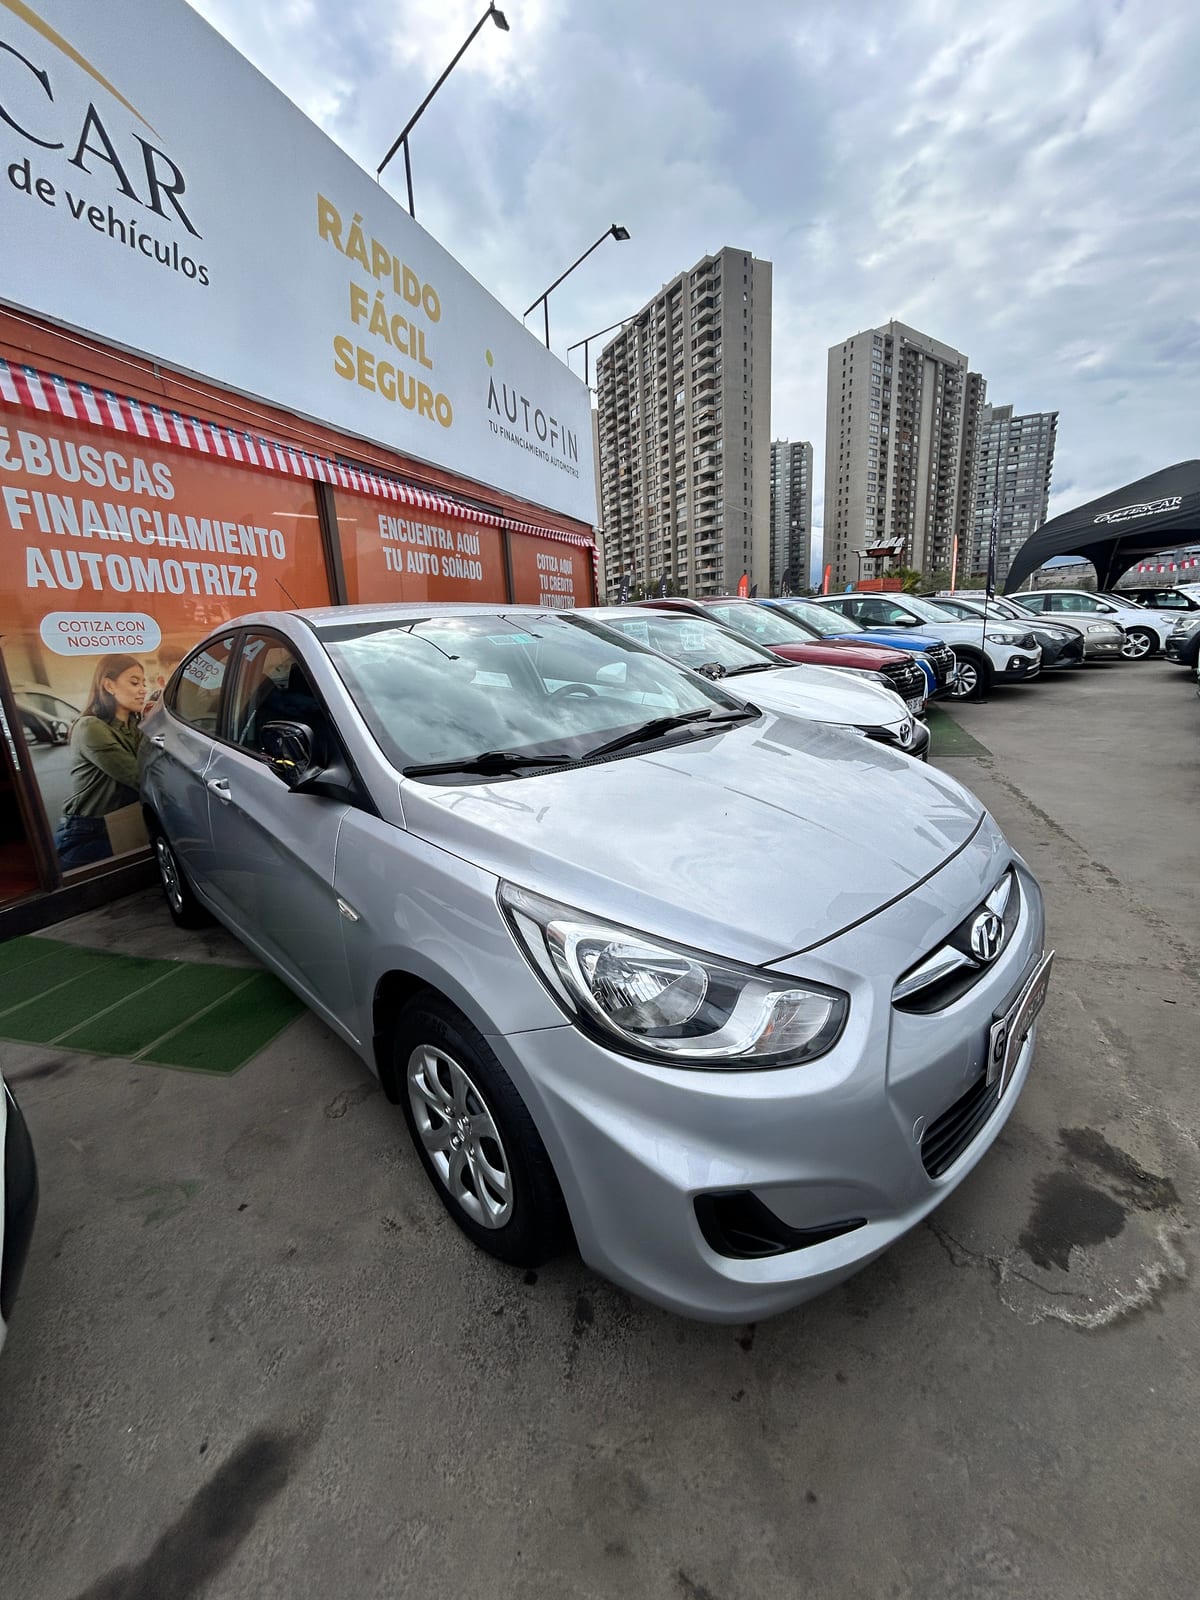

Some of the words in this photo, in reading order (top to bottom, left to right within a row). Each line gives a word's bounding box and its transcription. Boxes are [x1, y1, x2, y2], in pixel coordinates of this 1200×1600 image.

[7, 158, 56, 206] de
[65, 190, 209, 286] vehículos
[317, 192, 441, 323] RÁPIDO
[349, 280, 433, 370] FÁCIL
[333, 335, 453, 428] SEGURO
[487, 376, 578, 463] AUTOFIN
[488, 419, 498, 434] TU
[499, 426, 550, 462] FINANCIAMIENTO
[550, 456, 579, 478] AUTOMOTRIZ
[0, 427, 175, 500] ¿BUSCAS
[2, 486, 286, 560] FINANCIAMIENTO
[378, 514, 454, 550] ENCUENTRA
[456, 531, 480, 556] AQUÍ
[25, 546, 258, 597] AUTOMOTRIZ?
[383, 547, 402, 572] TU
[407, 550, 439, 576] AUTO
[442, 554, 483, 581] SOÑADO
[537, 553, 558, 572] COTIZA
[540, 574, 549, 590] TU
[550, 572, 573, 592] CRÉDITO
[58, 620, 113, 633] COTIZA
[115, 620, 145, 633] CON
[67, 634, 144, 649] NOSOTROS
